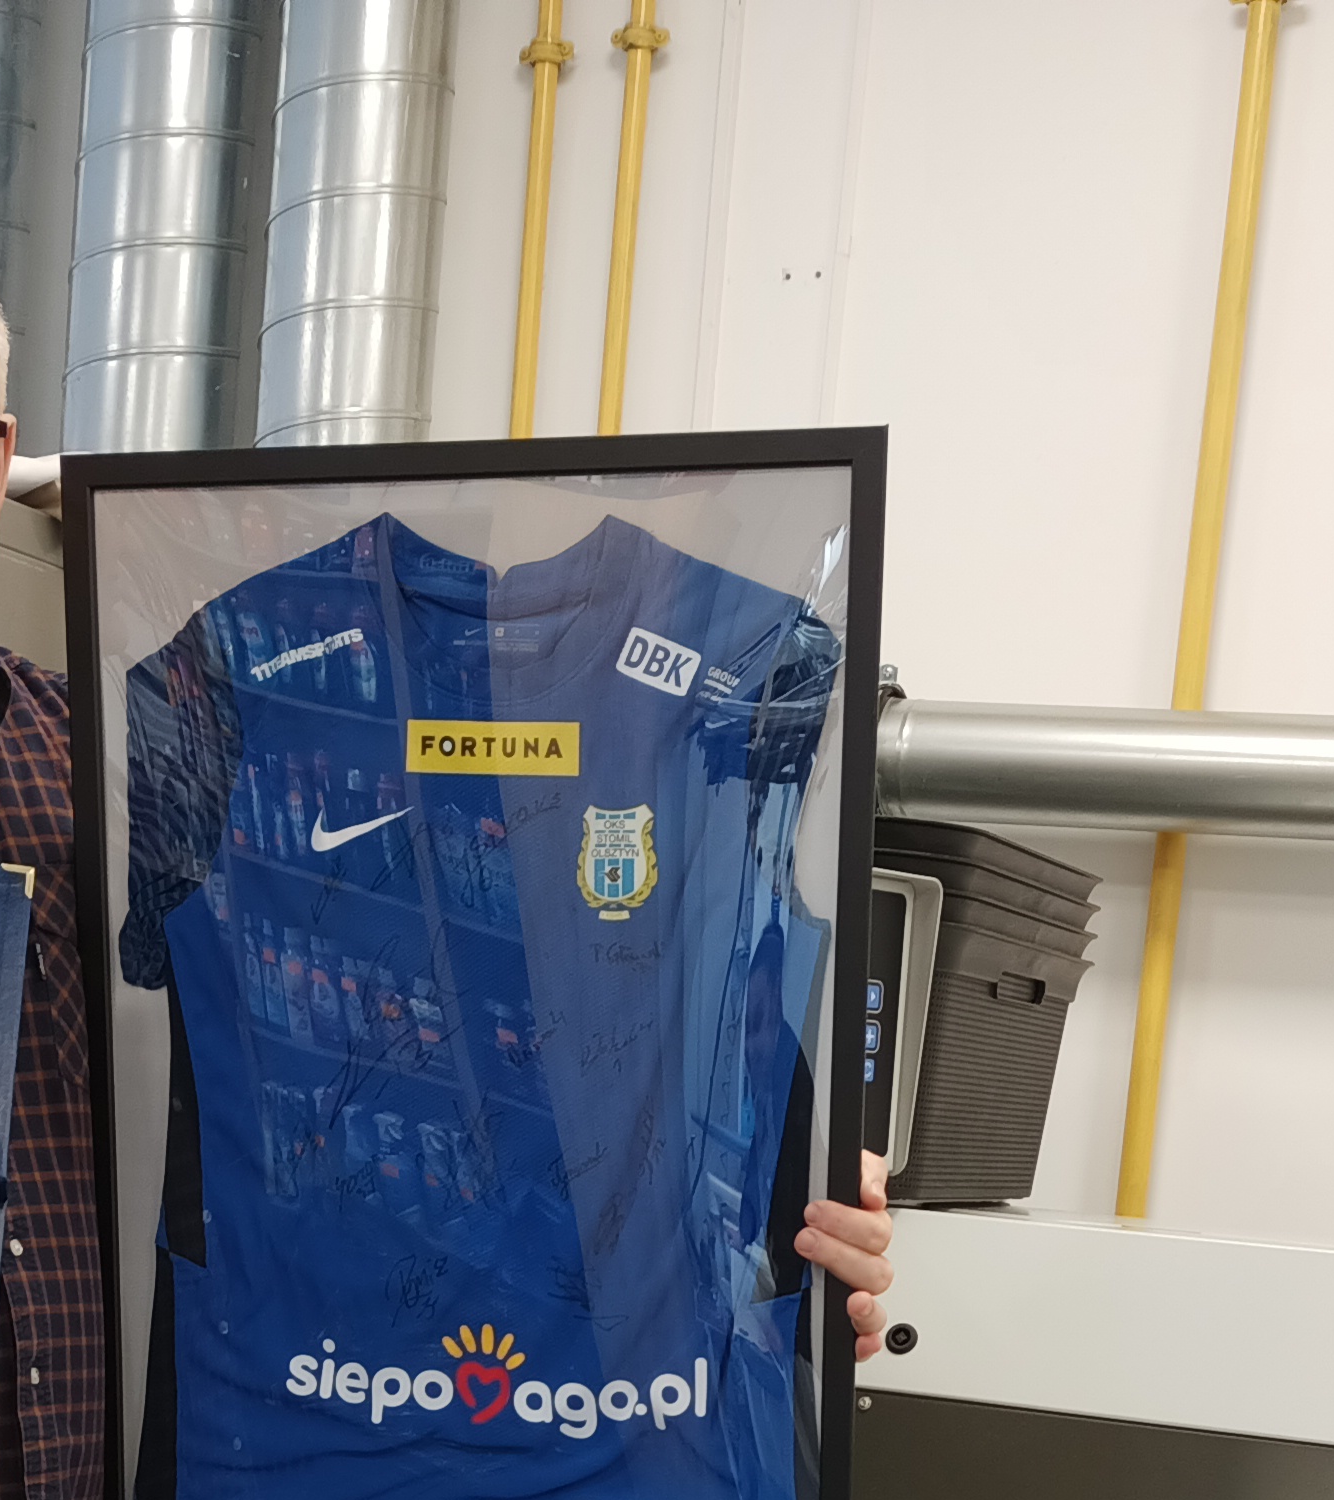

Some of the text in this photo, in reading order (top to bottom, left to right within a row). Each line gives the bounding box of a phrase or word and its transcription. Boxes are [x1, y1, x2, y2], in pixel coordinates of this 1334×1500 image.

[623, 634, 693, 689] DBK
[420, 734, 564, 761] FORTUNA
[603, 819, 626, 830] OKS
[596, 833, 633, 844] STOMIL
[590, 847, 640, 858] OLSZTYN
